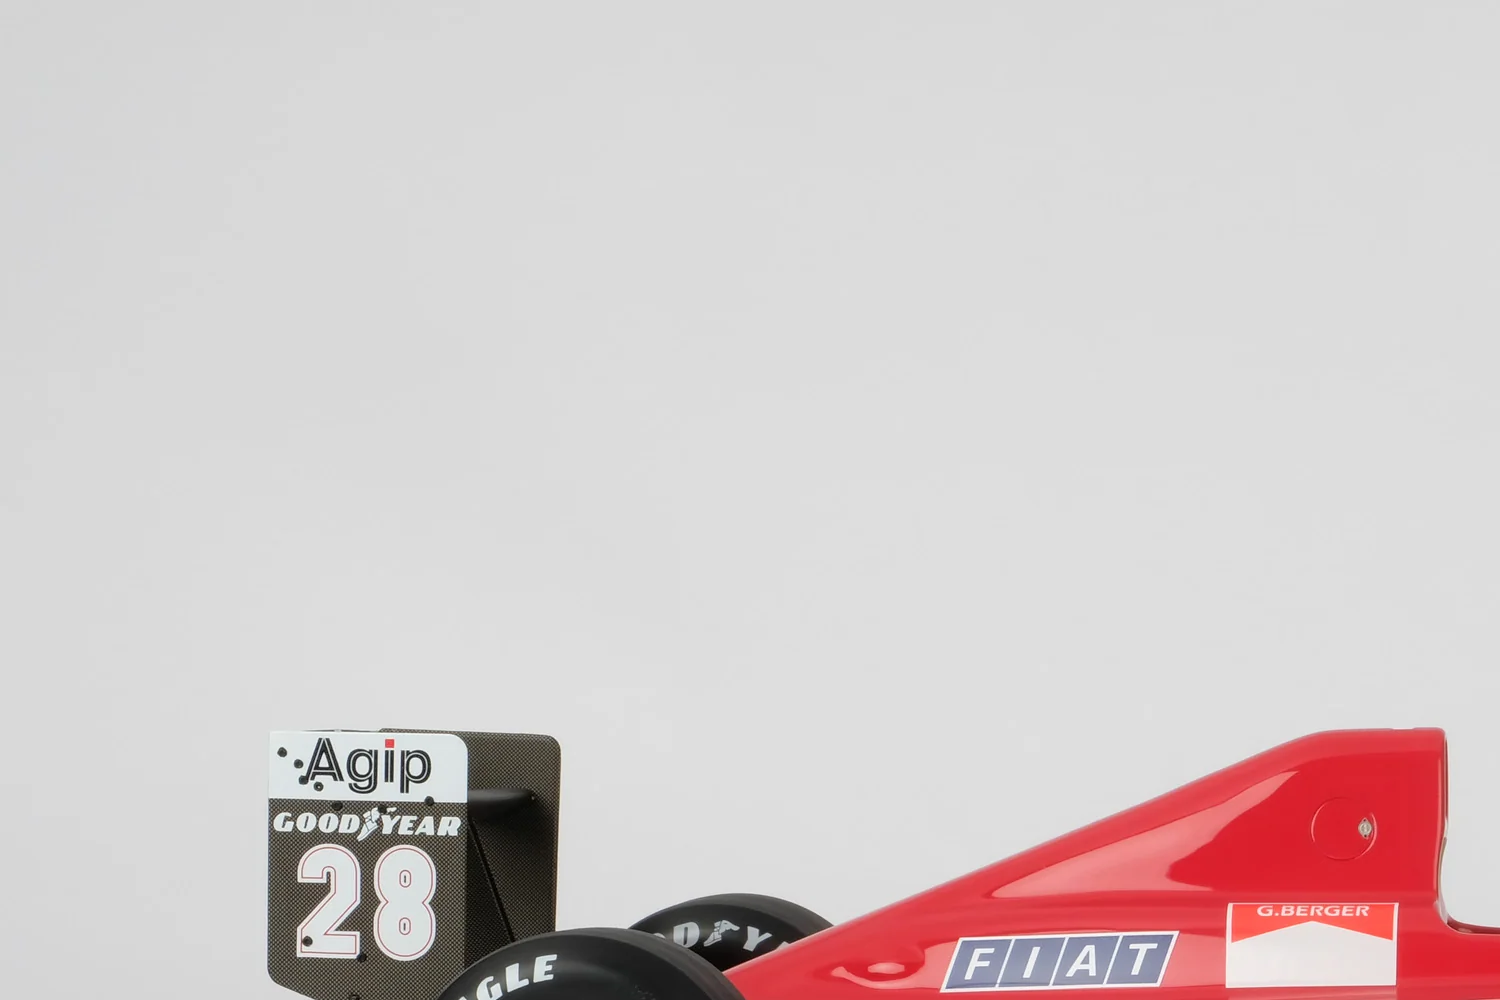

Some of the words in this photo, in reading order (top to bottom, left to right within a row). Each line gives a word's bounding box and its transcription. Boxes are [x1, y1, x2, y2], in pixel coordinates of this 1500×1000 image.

[305, 738, 432, 794] Agip
[296, 843, 436, 961] 28
[1256, 905, 1370, 918] G.BERGER
[964, 942, 1159, 980] FIAT
